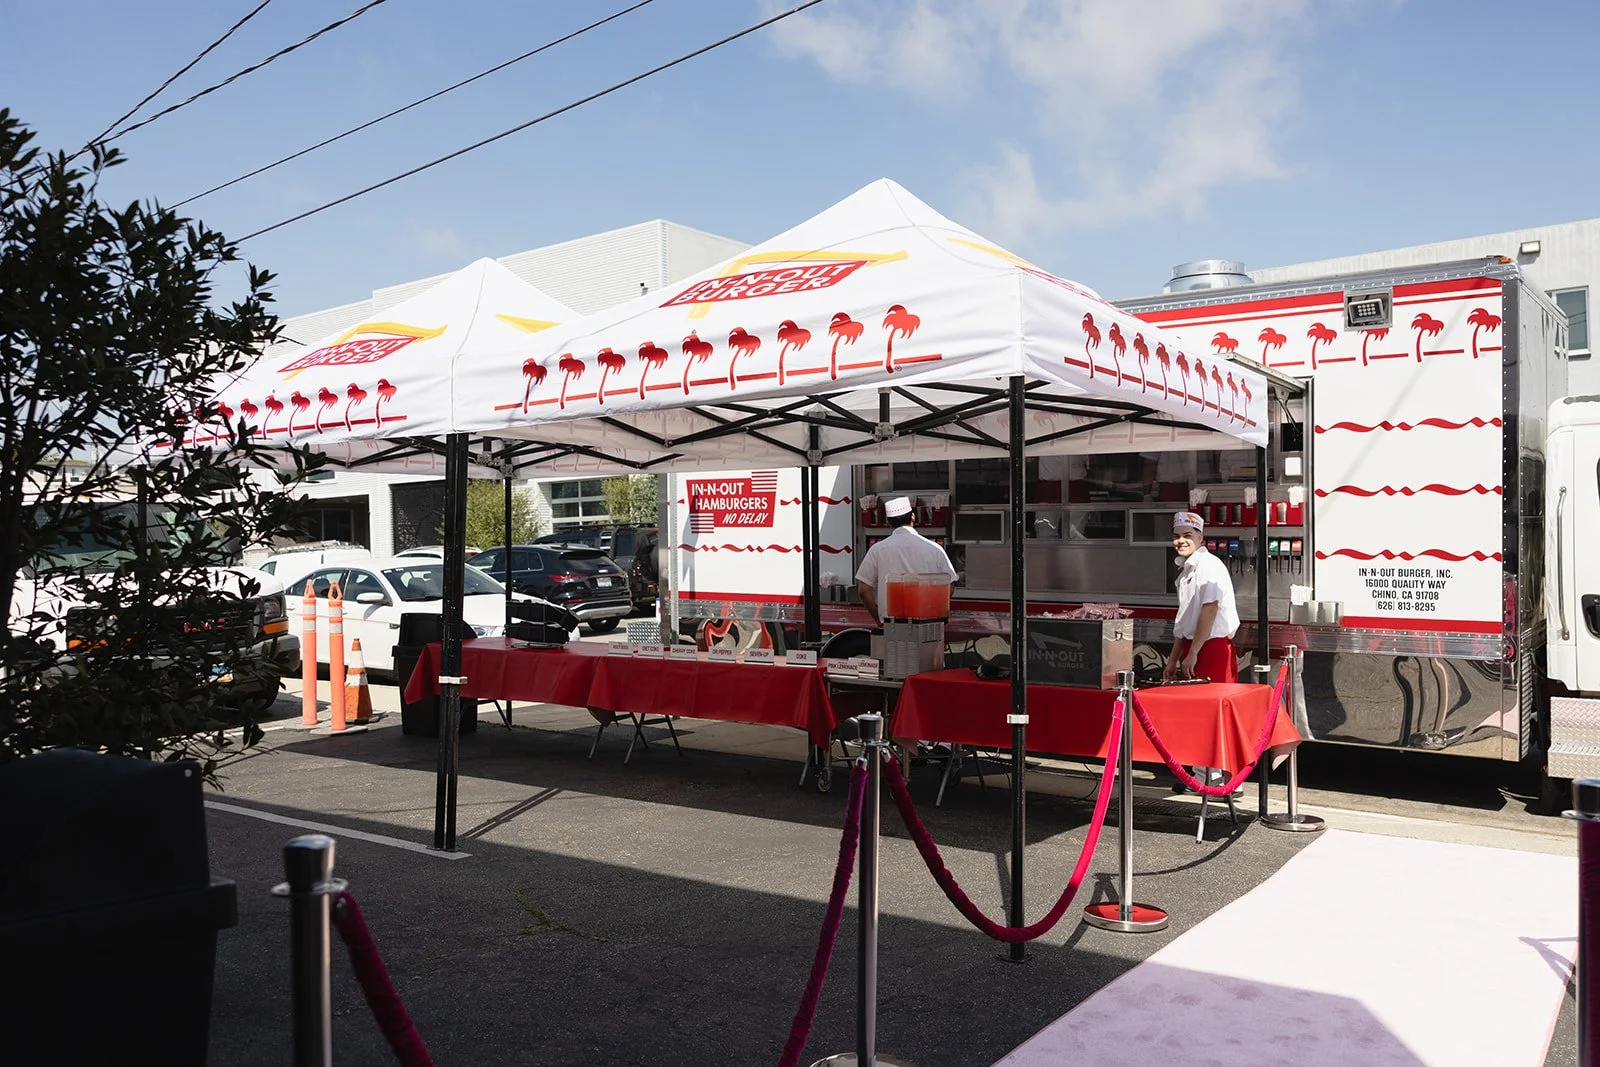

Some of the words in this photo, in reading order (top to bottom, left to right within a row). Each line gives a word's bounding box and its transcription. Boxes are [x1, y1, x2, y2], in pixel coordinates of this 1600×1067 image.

[693, 264, 854, 293] IN-N-OUT
[310, 339, 409, 358] IN-N-OUT
[691, 482, 744, 496] IN-N-OUT
[695, 497, 768, 510] HAMBURGERS
[722, 513, 737, 524] NO
[737, 513, 768, 524] DELAY
[1358, 568, 1395, 577] IN-N-OUT
[1398, 568, 1434, 579] BURGER,
[1436, 569, 1453, 579] INC.
[1365, 579, 1389, 588] 16000
[1391, 580, 1425, 589] QUALITY
[1427, 580, 1447, 589] WAY
[1371, 590, 1399, 600] CHINO,
[1401, 591, 1413, 600] CA
[1415, 591, 1439, 600] 91708
[1376, 600, 1395, 611] (626)
[1397, 602, 1436, 611] 813-8295
